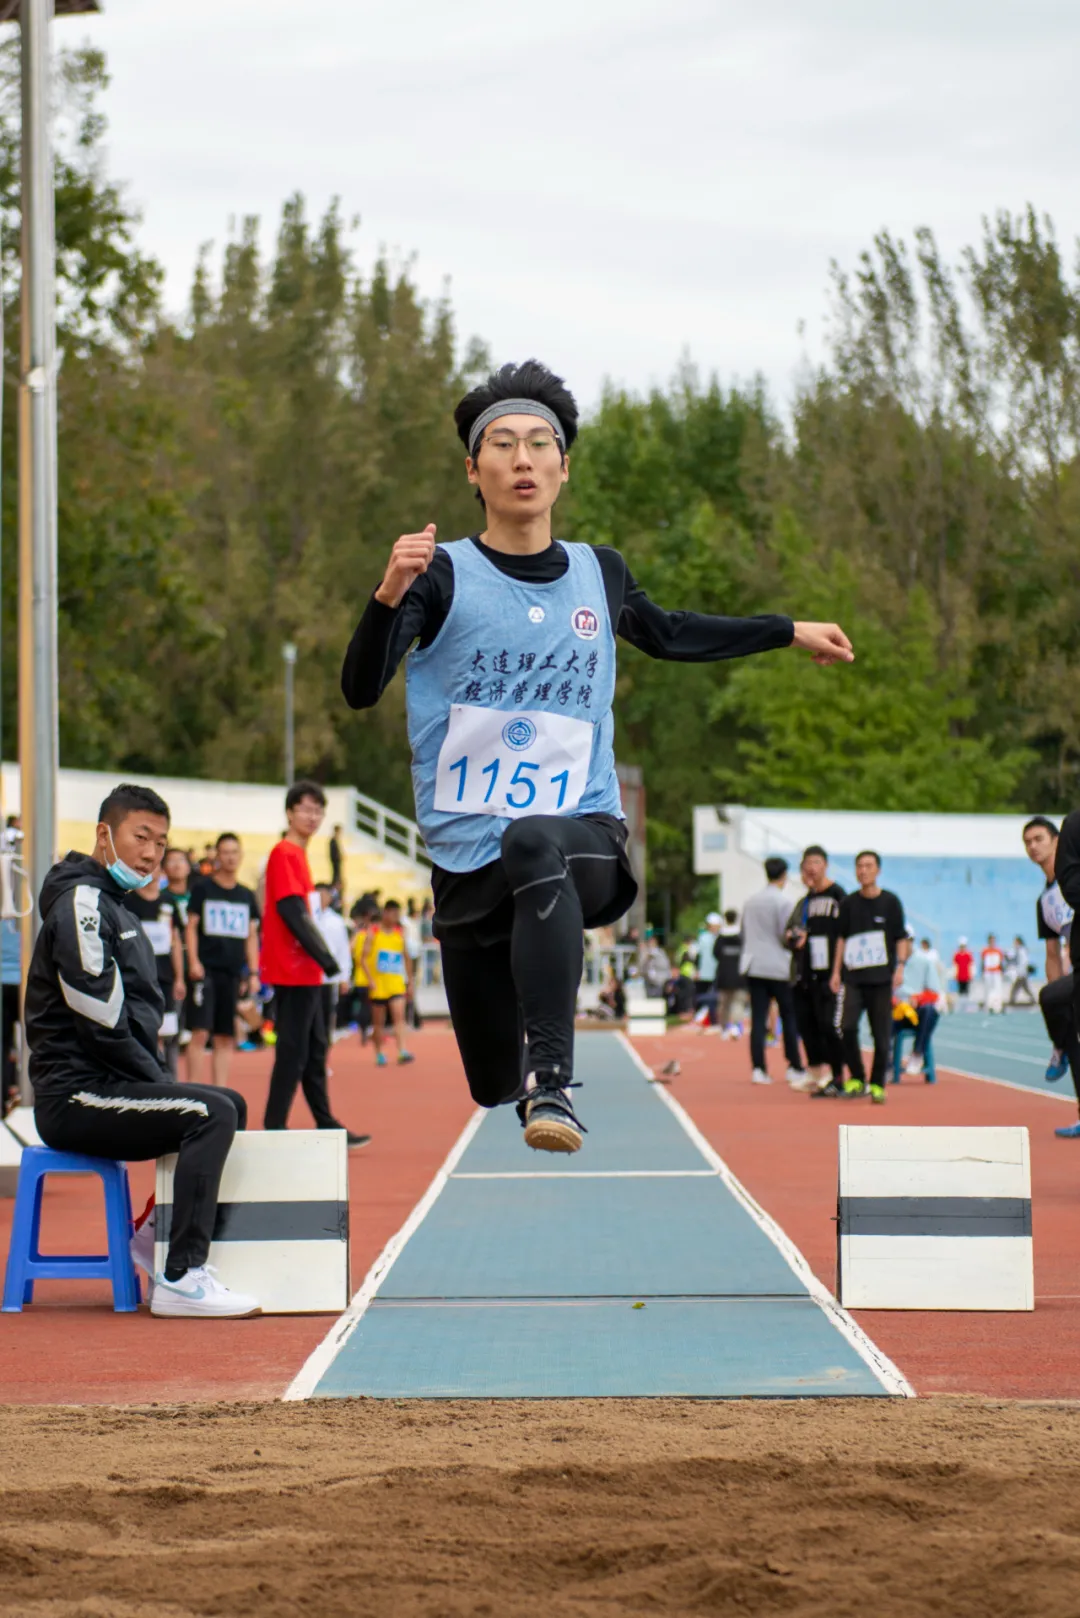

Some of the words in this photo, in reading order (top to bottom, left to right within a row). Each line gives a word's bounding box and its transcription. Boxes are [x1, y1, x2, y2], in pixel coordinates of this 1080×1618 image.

[471, 648, 598, 679] 大连理工大学
[465, 680, 593, 708] 经济管理学院
[449, 756, 569, 809] 1151
